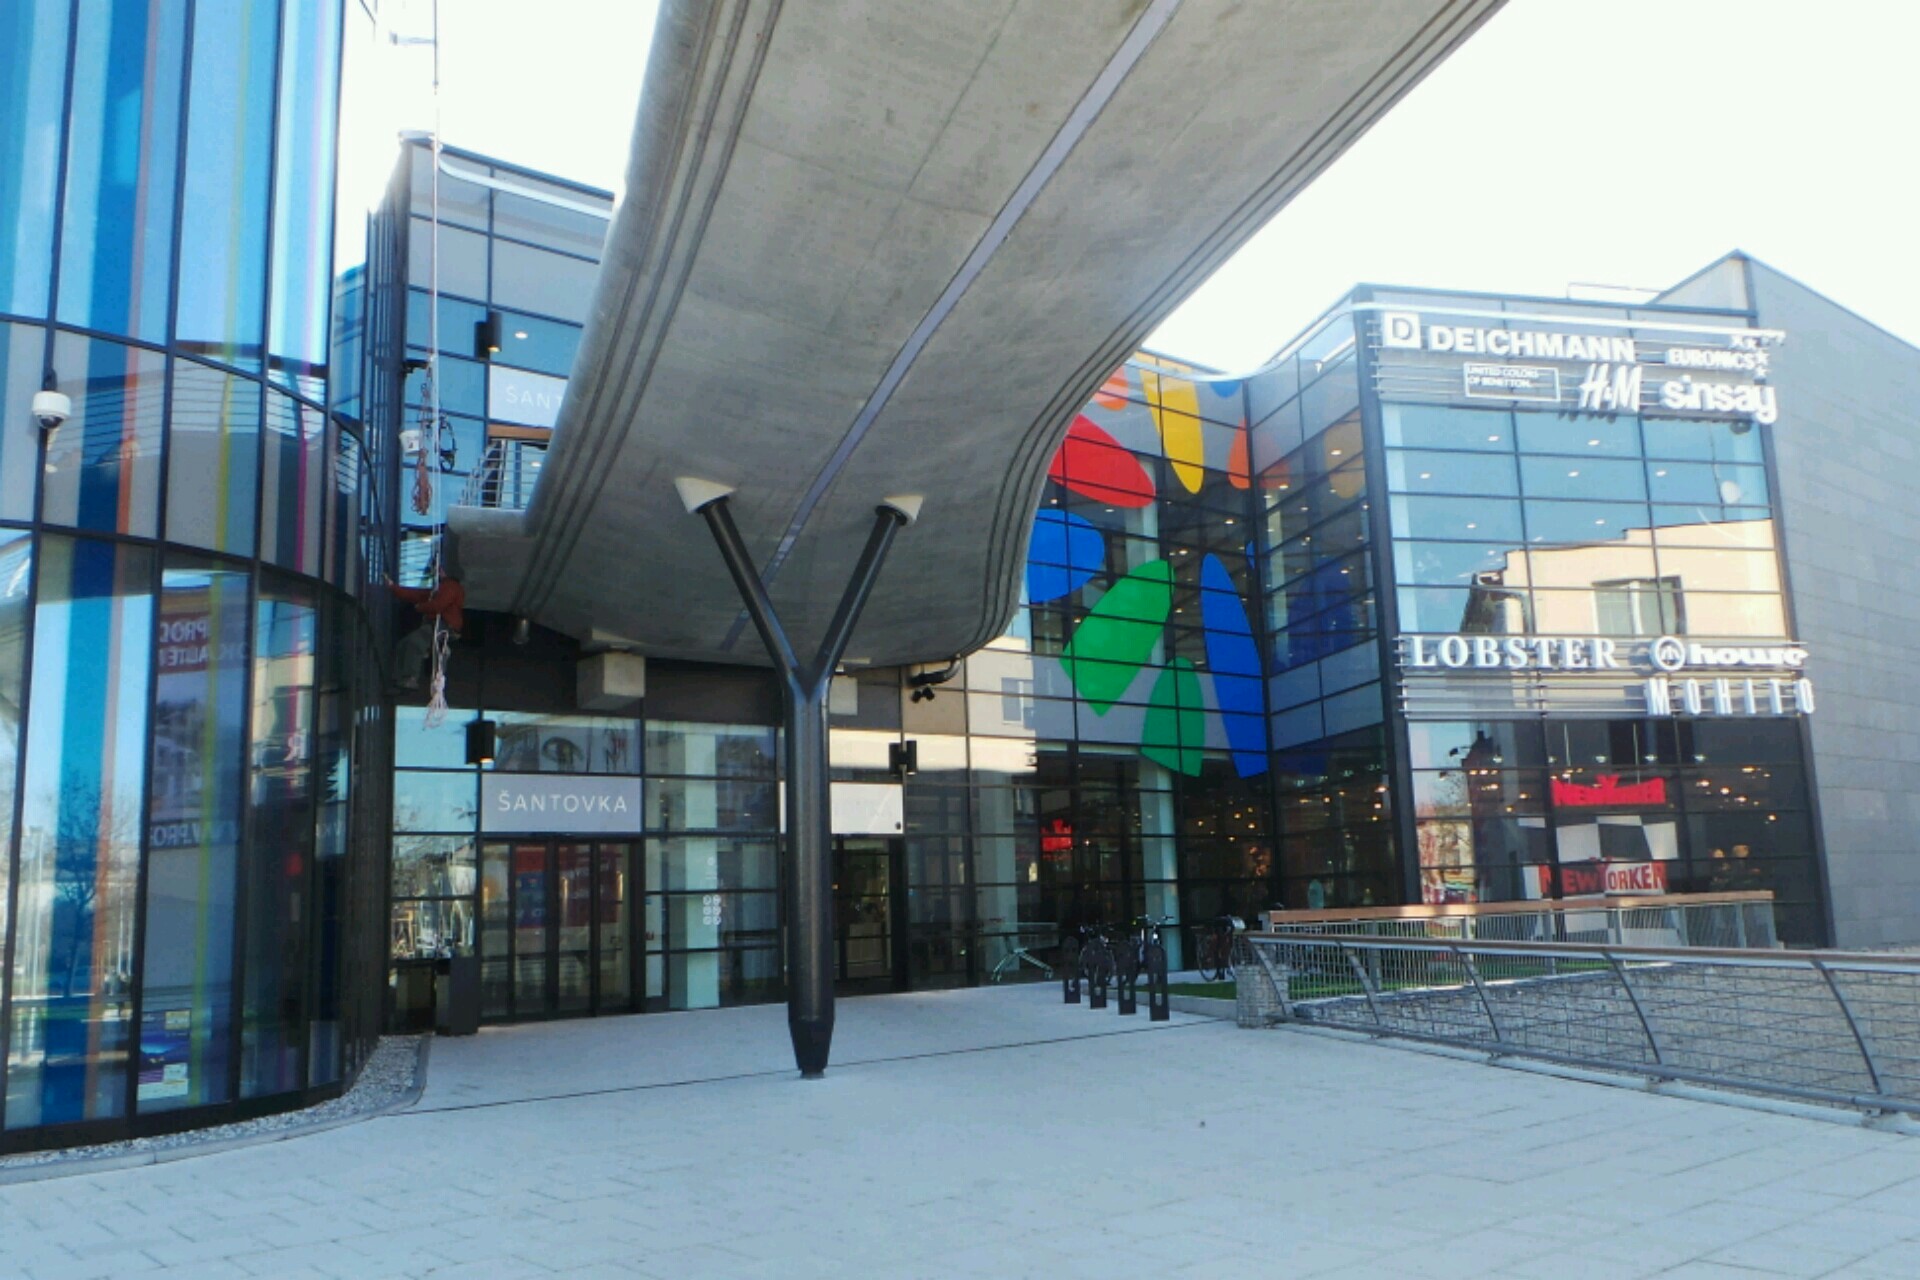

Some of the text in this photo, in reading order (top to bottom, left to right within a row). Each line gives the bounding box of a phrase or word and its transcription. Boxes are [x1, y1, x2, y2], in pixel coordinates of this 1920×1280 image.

[1429, 325, 1636, 363] DEICHMANN
[1667, 347, 1756, 371] EURONICS
[1579, 362, 1643, 413] H&M
[1660, 374, 1778, 425] sinsay
[1411, 634, 1621, 669] LOBSTER
[1644, 676, 1815, 715] MOHITO
[498, 790, 627, 813] ŠANTOVKA
